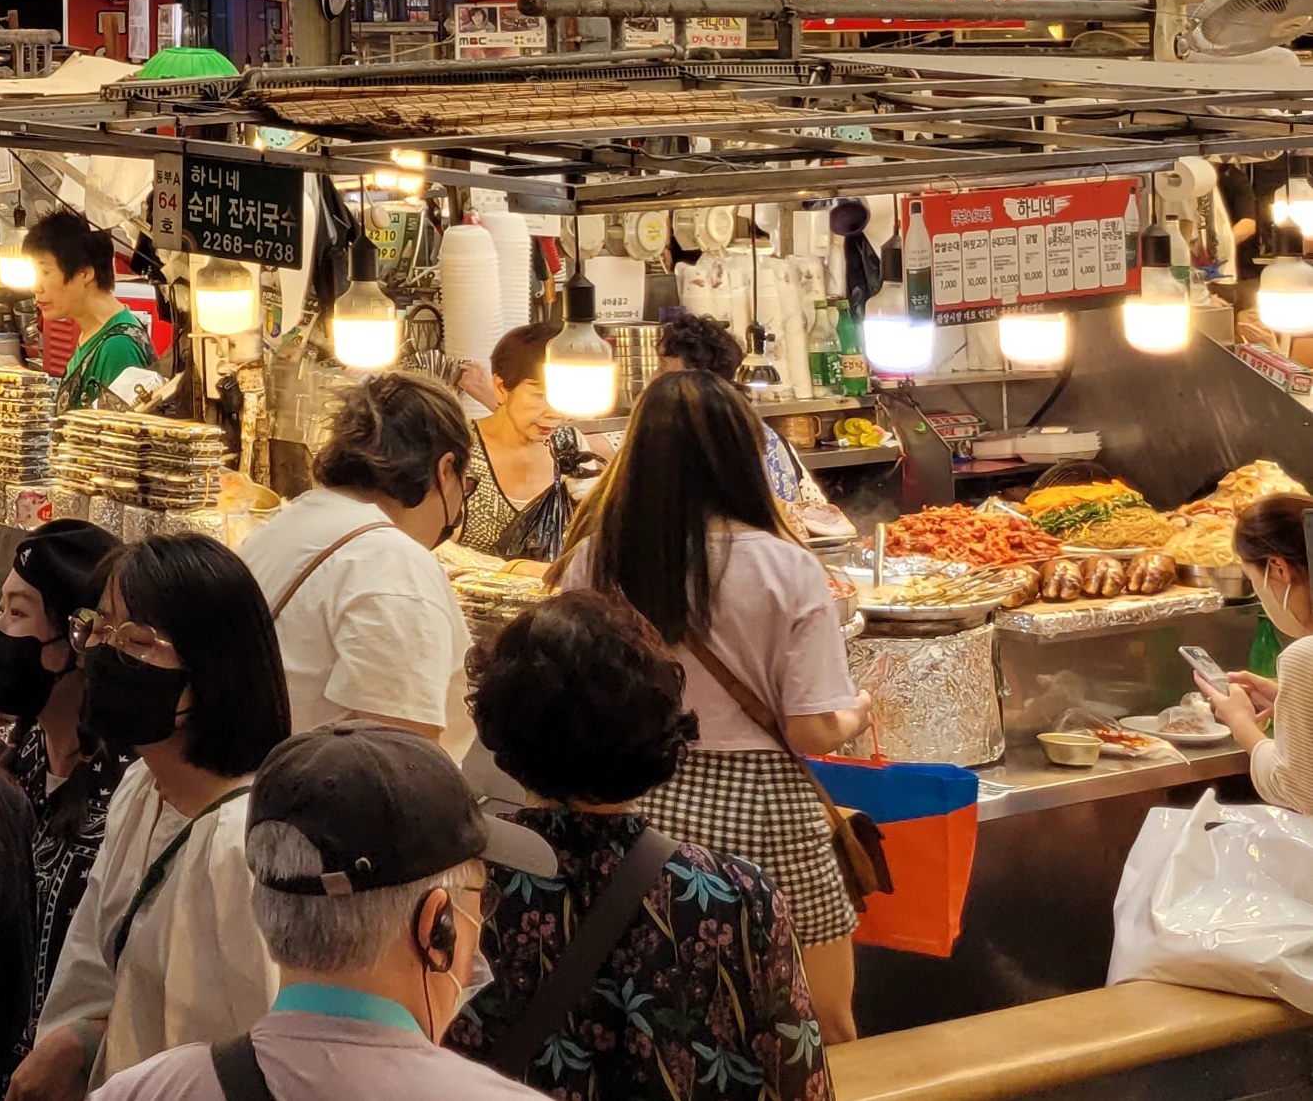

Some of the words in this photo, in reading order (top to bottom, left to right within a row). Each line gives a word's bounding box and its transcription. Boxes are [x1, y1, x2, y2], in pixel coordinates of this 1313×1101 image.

[459, 36, 487, 45] MBC
[156, 170, 181, 186] 동부A
[190, 164, 240, 192] 하니네
[158, 191, 178, 210] 64
[1016, 196, 1055, 218] 하니네
[187, 190, 221, 227] 순대
[228, 195, 298, 238] 잔치국수
[159, 217, 175, 235] 호
[202, 229, 295, 263] 2268-6738
[940, 279, 957, 290] 7,000
